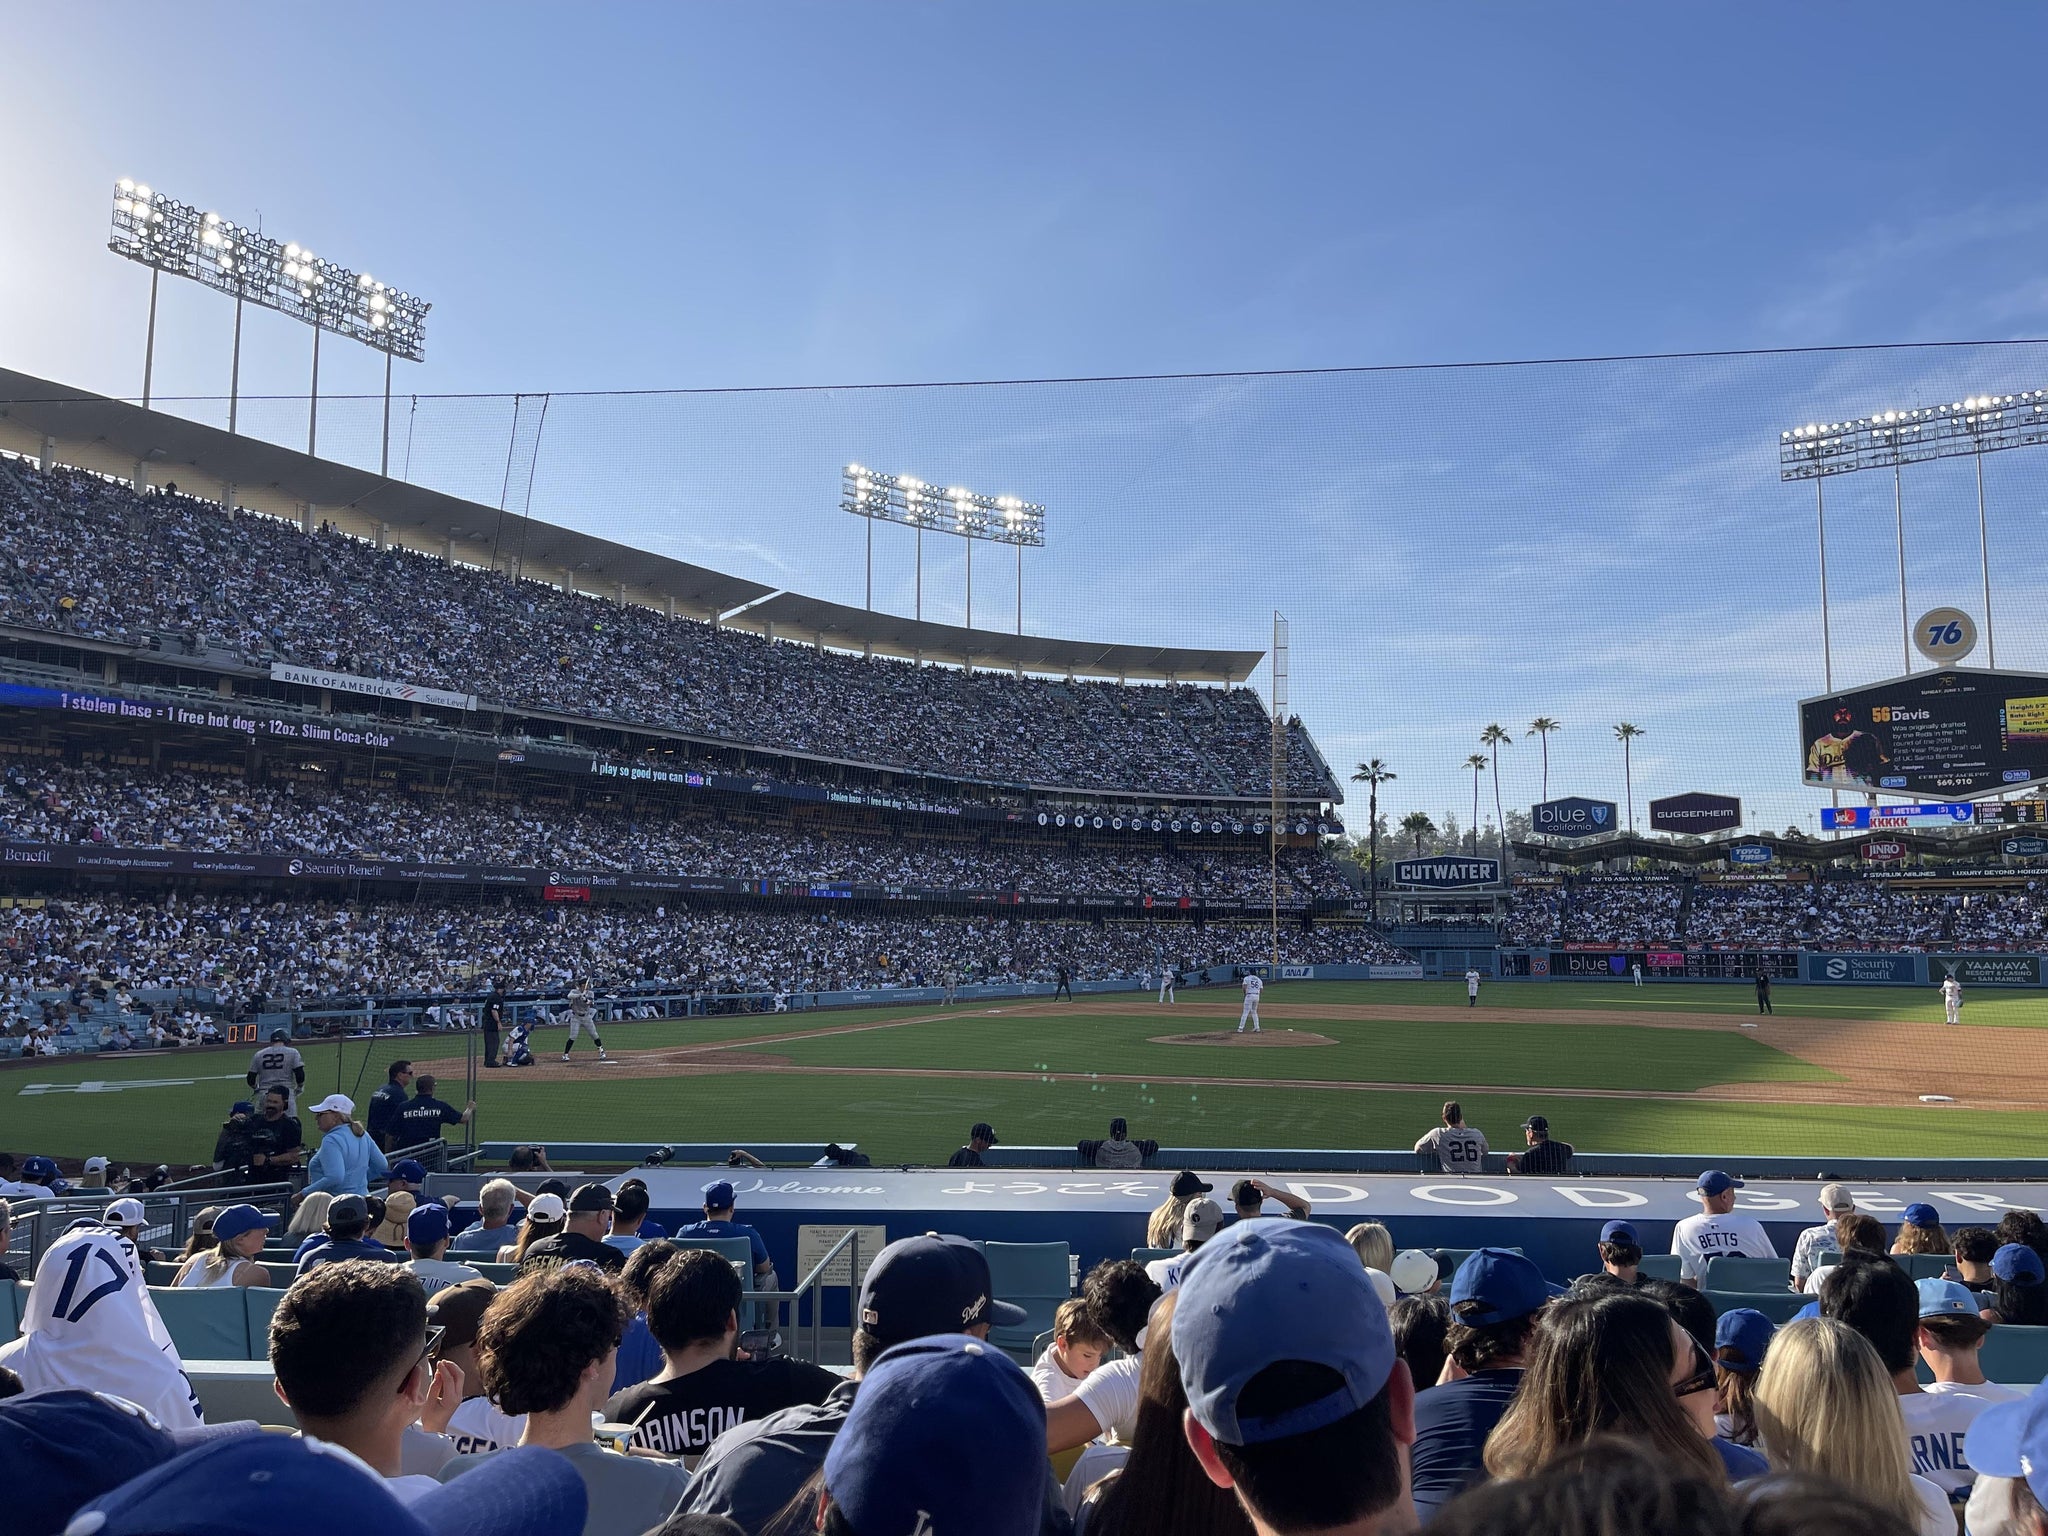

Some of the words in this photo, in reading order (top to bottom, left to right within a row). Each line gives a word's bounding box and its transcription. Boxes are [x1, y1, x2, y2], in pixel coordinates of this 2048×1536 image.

[1928, 621, 1962, 646] 76
[284, 671, 319, 685] BANK
[321, 677, 338, 688] OF
[339, 681, 393, 696] AMERICA
[425, 694, 446, 705] Suite
[447, 697, 469, 709] Level
[61, 693, 67, 708] 1
[72, 696, 116, 714] stolen
[120, 701, 152, 719] base
[168, 706, 174, 721] 1
[177, 708, 205, 725] free
[208, 712, 229, 728] hot
[232, 715, 256, 734] dog
[269, 719, 298, 737] 12oz.
[1871, 706, 1891, 723] 56
[1891, 708, 1930, 721] Davis
[2027, 711, 2045, 719] Right
[1892, 724, 1908, 732] Was
[1908, 722, 1939, 731] originally
[1940, 721, 1967, 729] drafted
[591, 760, 598, 773] A
[600, 762, 618, 777] play
[619, 765, 629, 777] so
[631, 767, 651, 780] good
[653, 771, 667, 782] you
[669, 772, 683, 783] can
[685, 774, 704, 786] taste
[705, 775, 713, 787] it
[1936, 778, 1973, 787] $69,910
[830, 793, 848, 803] stolen
[849, 795, 862, 804] base
[870, 796, 882, 806] free
[882, 797, 891, 807] hot
[892, 798, 902, 810] dog
[1539, 806, 1586, 823] blue
[1657, 809, 1734, 819] GUGGENHEIM
[1937, 806, 1949, 814] (5)
[1956, 806, 1967, 819] LA
[1172, 822, 1181, 830] 32
[1192, 823, 1201, 831] 34
[1212, 824, 1221, 832] 39
[1233, 824, 1242, 832] 42
[1547, 823, 1592, 831] california
[1869, 844, 1900, 857] JINRO
[2019, 841, 2044, 849] Security
[4, 848, 52, 863] Benefit
[77, 856, 87, 864] To
[87, 857, 102, 865] and
[102, 857, 132, 868] Through
[132, 859, 173, 868] Retirement
[305, 862, 346, 877] Security
[349, 865, 385, 877] Benefit
[1401, 864, 1491, 880] CUTWATER
[560, 874, 591, 886] Security
[592, 875, 620, 886] Benefit
[1029, 895, 1059, 904] Budweiser
[1083, 897, 1116, 905] Budweiser
[1205, 900, 1242, 908] Budweiser
[1353, 901, 1368, 909] 6:09
[1533, 962, 1546, 971] 76
[1570, 955, 1608, 971] blue
[1850, 958, 1896, 970] Security
[1284, 968, 1302, 977] ANA
[1852, 969, 1892, 980] Benefit
[1250, 980, 1259, 989] 56
[262, 1053, 285, 1070] 22
[403, 1109, 441, 1119] SECURITY
[1448, 1140, 1478, 1162] 26
[700, 1178, 885, 1195] Welcome
[941, 1181, 1159, 1197] ようこそ
[1286, 1183, 2046, 1211] DODGER
[1698, 1232, 1738, 1249] BETTS
[51, 1242, 130, 1323] 17
[962, 1293, 986, 1324] Dodgers
[631, 1406, 745, 1452] OBINSON
